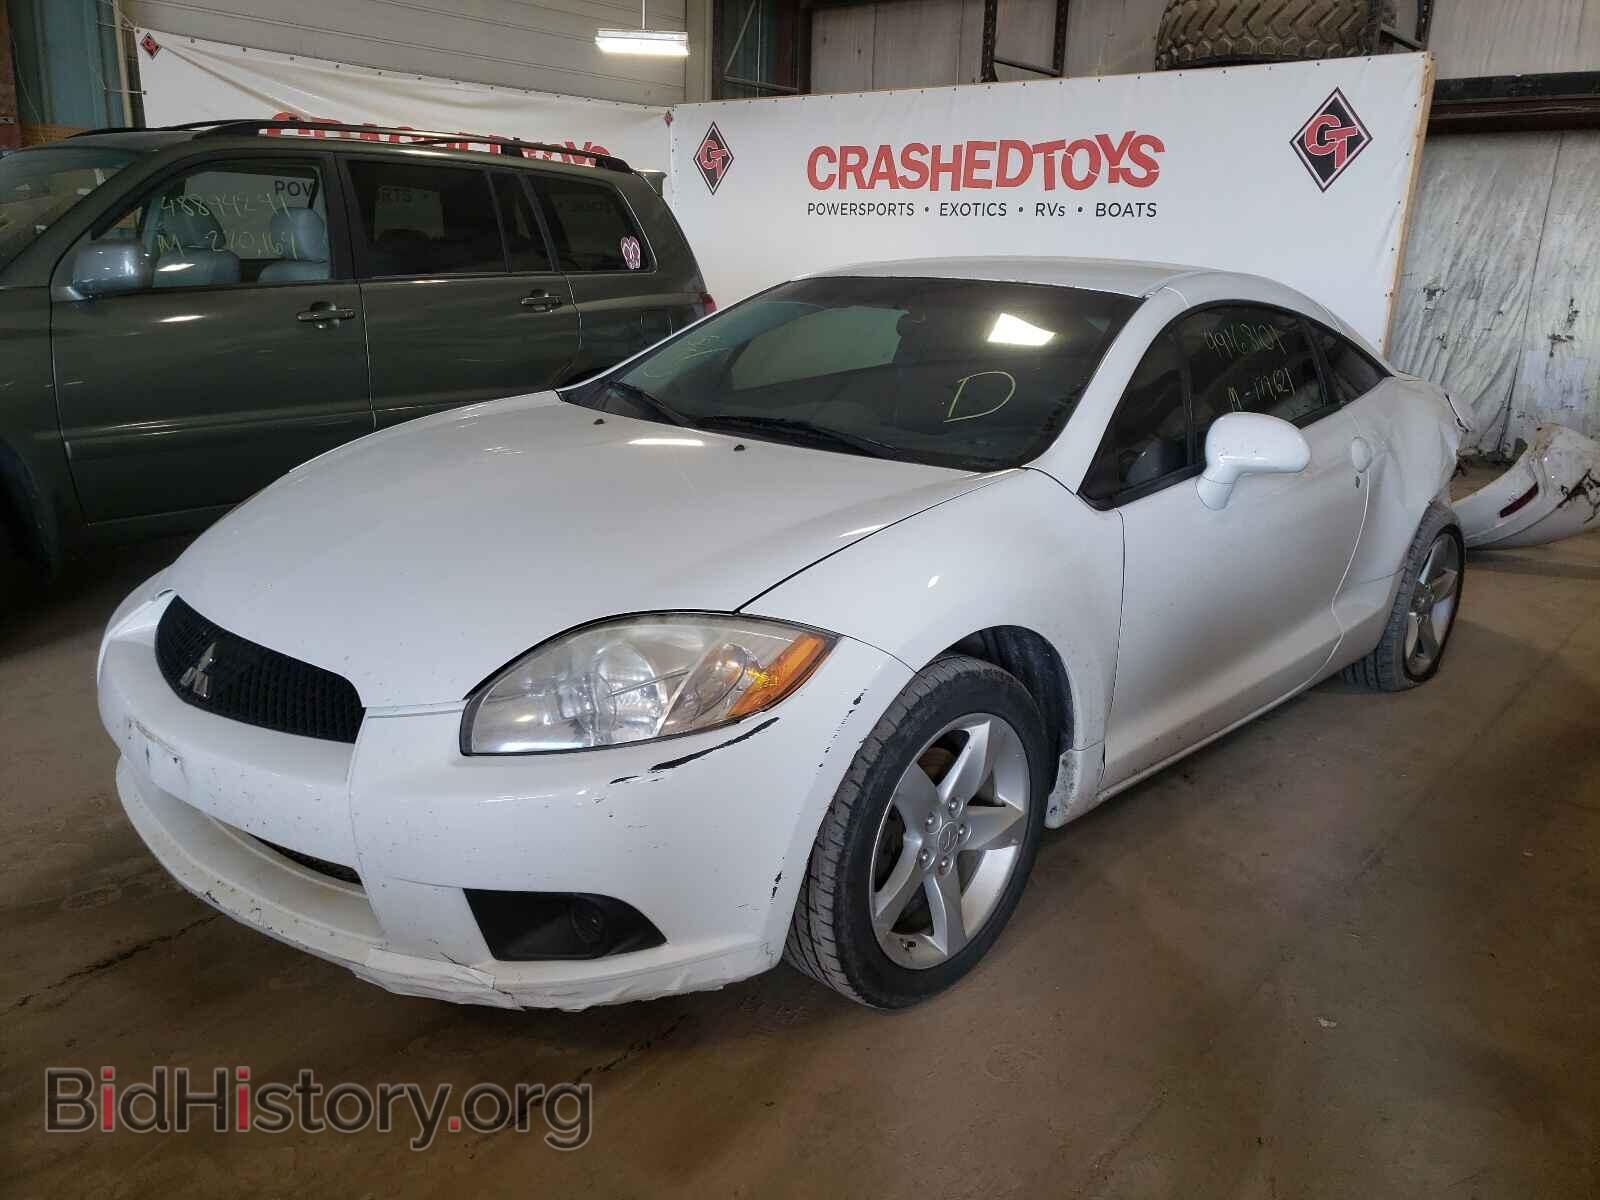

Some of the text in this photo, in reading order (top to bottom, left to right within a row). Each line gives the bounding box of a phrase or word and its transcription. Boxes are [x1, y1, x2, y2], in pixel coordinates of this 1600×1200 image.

[806, 130, 1166, 192] CRASHEDTOYS
[806, 202, 1157, 218] POWERSPORTS EXOTICS RVs BOATS
[943, 369, 1016, 423] D
